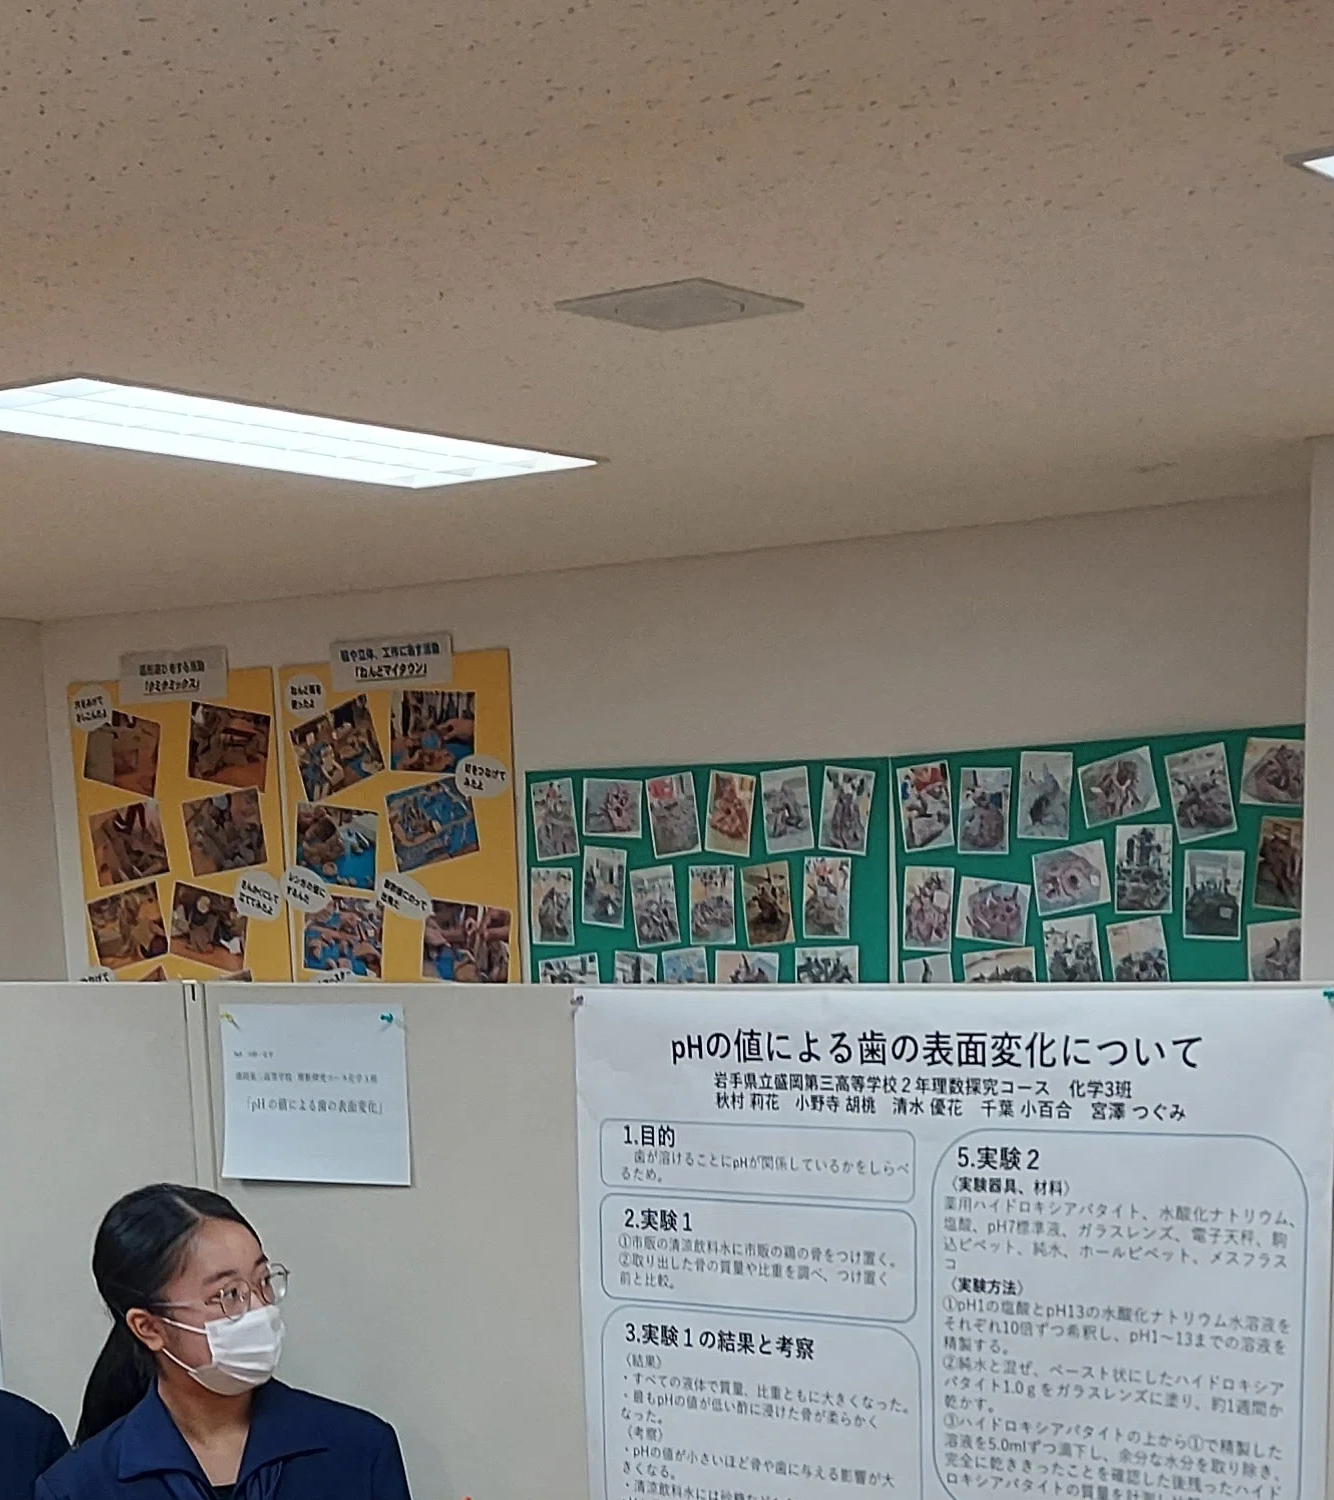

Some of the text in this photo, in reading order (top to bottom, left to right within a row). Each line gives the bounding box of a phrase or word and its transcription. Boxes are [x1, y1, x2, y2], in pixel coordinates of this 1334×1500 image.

[670, 1027, 1204, 1069] pHの値による歯の表面変化について
[1069, 1080, 1132, 1099] 化学3班
[796, 1096, 841, 1113] 小野寺
[981, 1100, 1014, 1118] 千葉
[1021, 1101, 1072, 1119] 小百合
[1132, 1104, 1186, 1122] つぐみ
[623, 1125, 675, 1148] 1.目的
[958, 1147, 1039, 1171] 5.実験2
[625, 1209, 693, 1232] 2.実験1
[625, 1323, 815, 1360] 3.実験1の結果と考察
